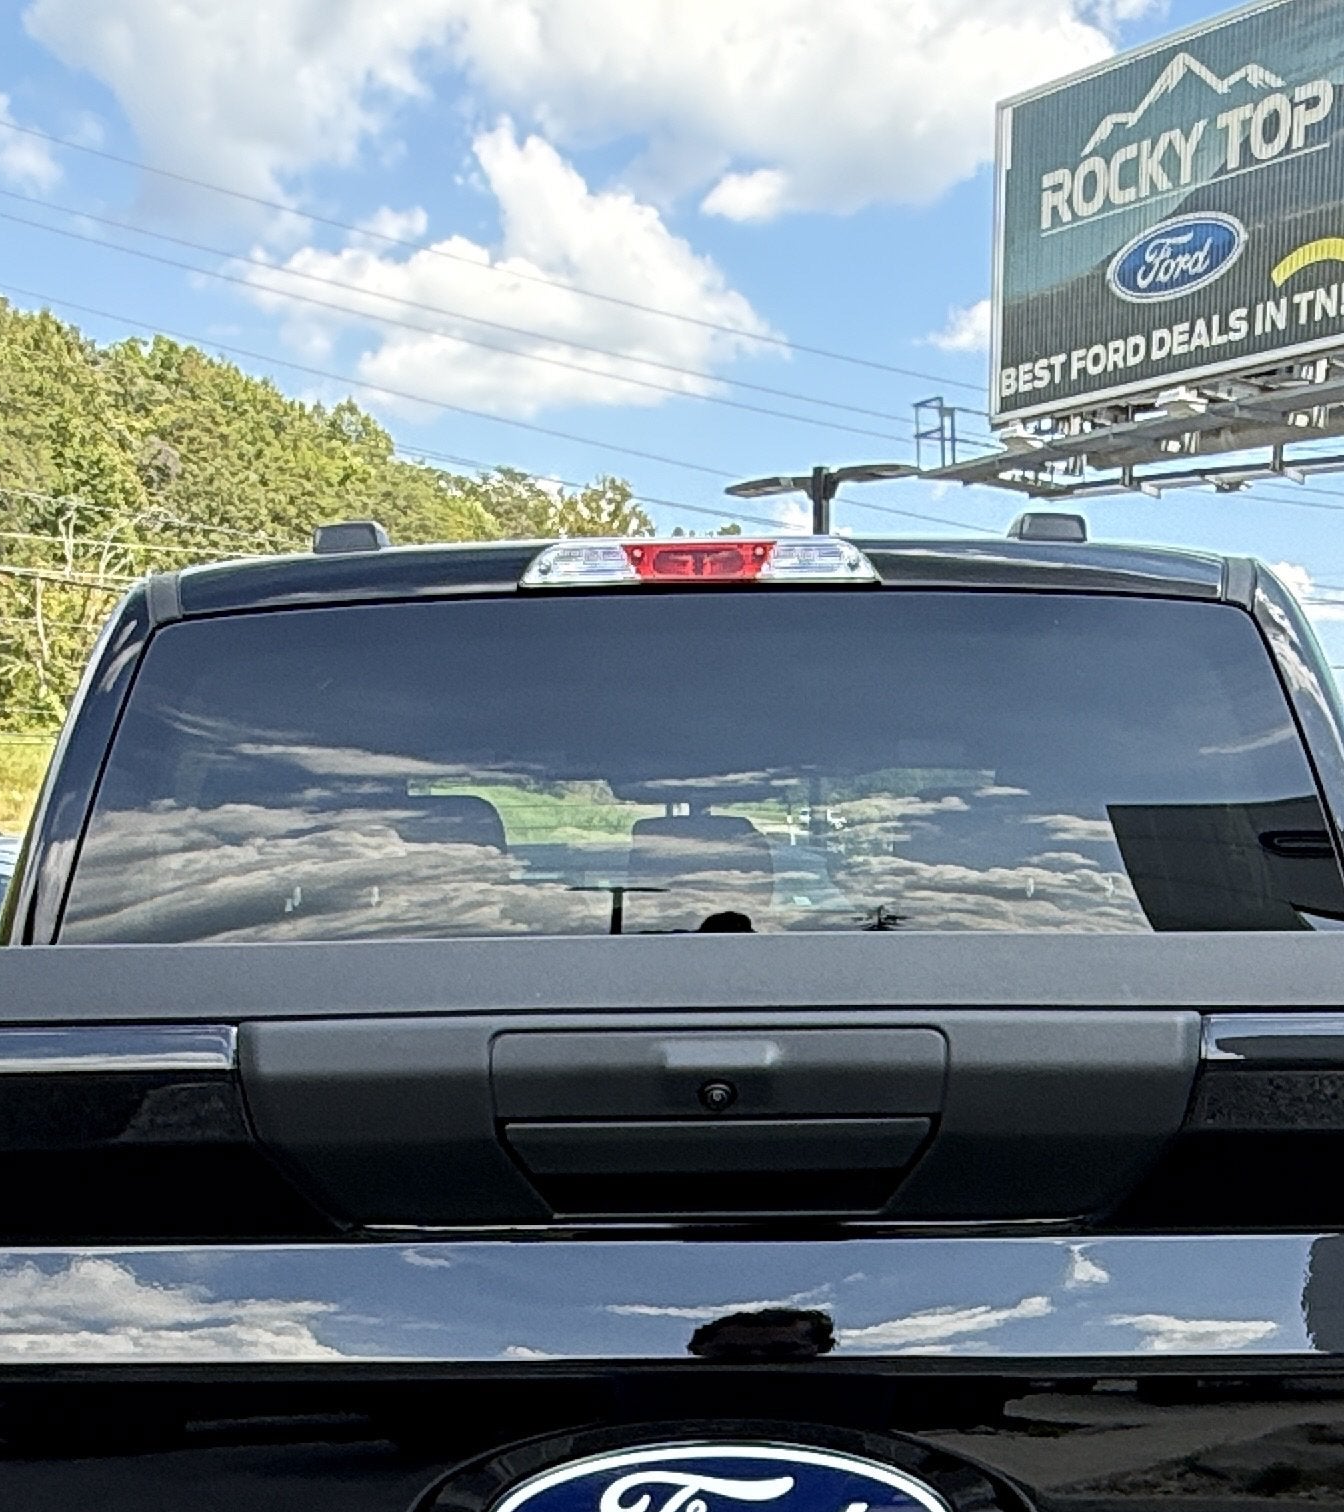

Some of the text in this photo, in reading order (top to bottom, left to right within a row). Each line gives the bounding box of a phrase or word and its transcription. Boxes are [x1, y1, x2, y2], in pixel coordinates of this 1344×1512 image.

[1041, 79, 1334, 230] ROCKY TOP
[1136, 230, 1212, 288] Ford
[1001, 353, 1067, 397] BEST
[1070, 334, 1146, 381] FORD
[1151, 307, 1249, 361] DEALS
[1255, 296, 1288, 336] IN
